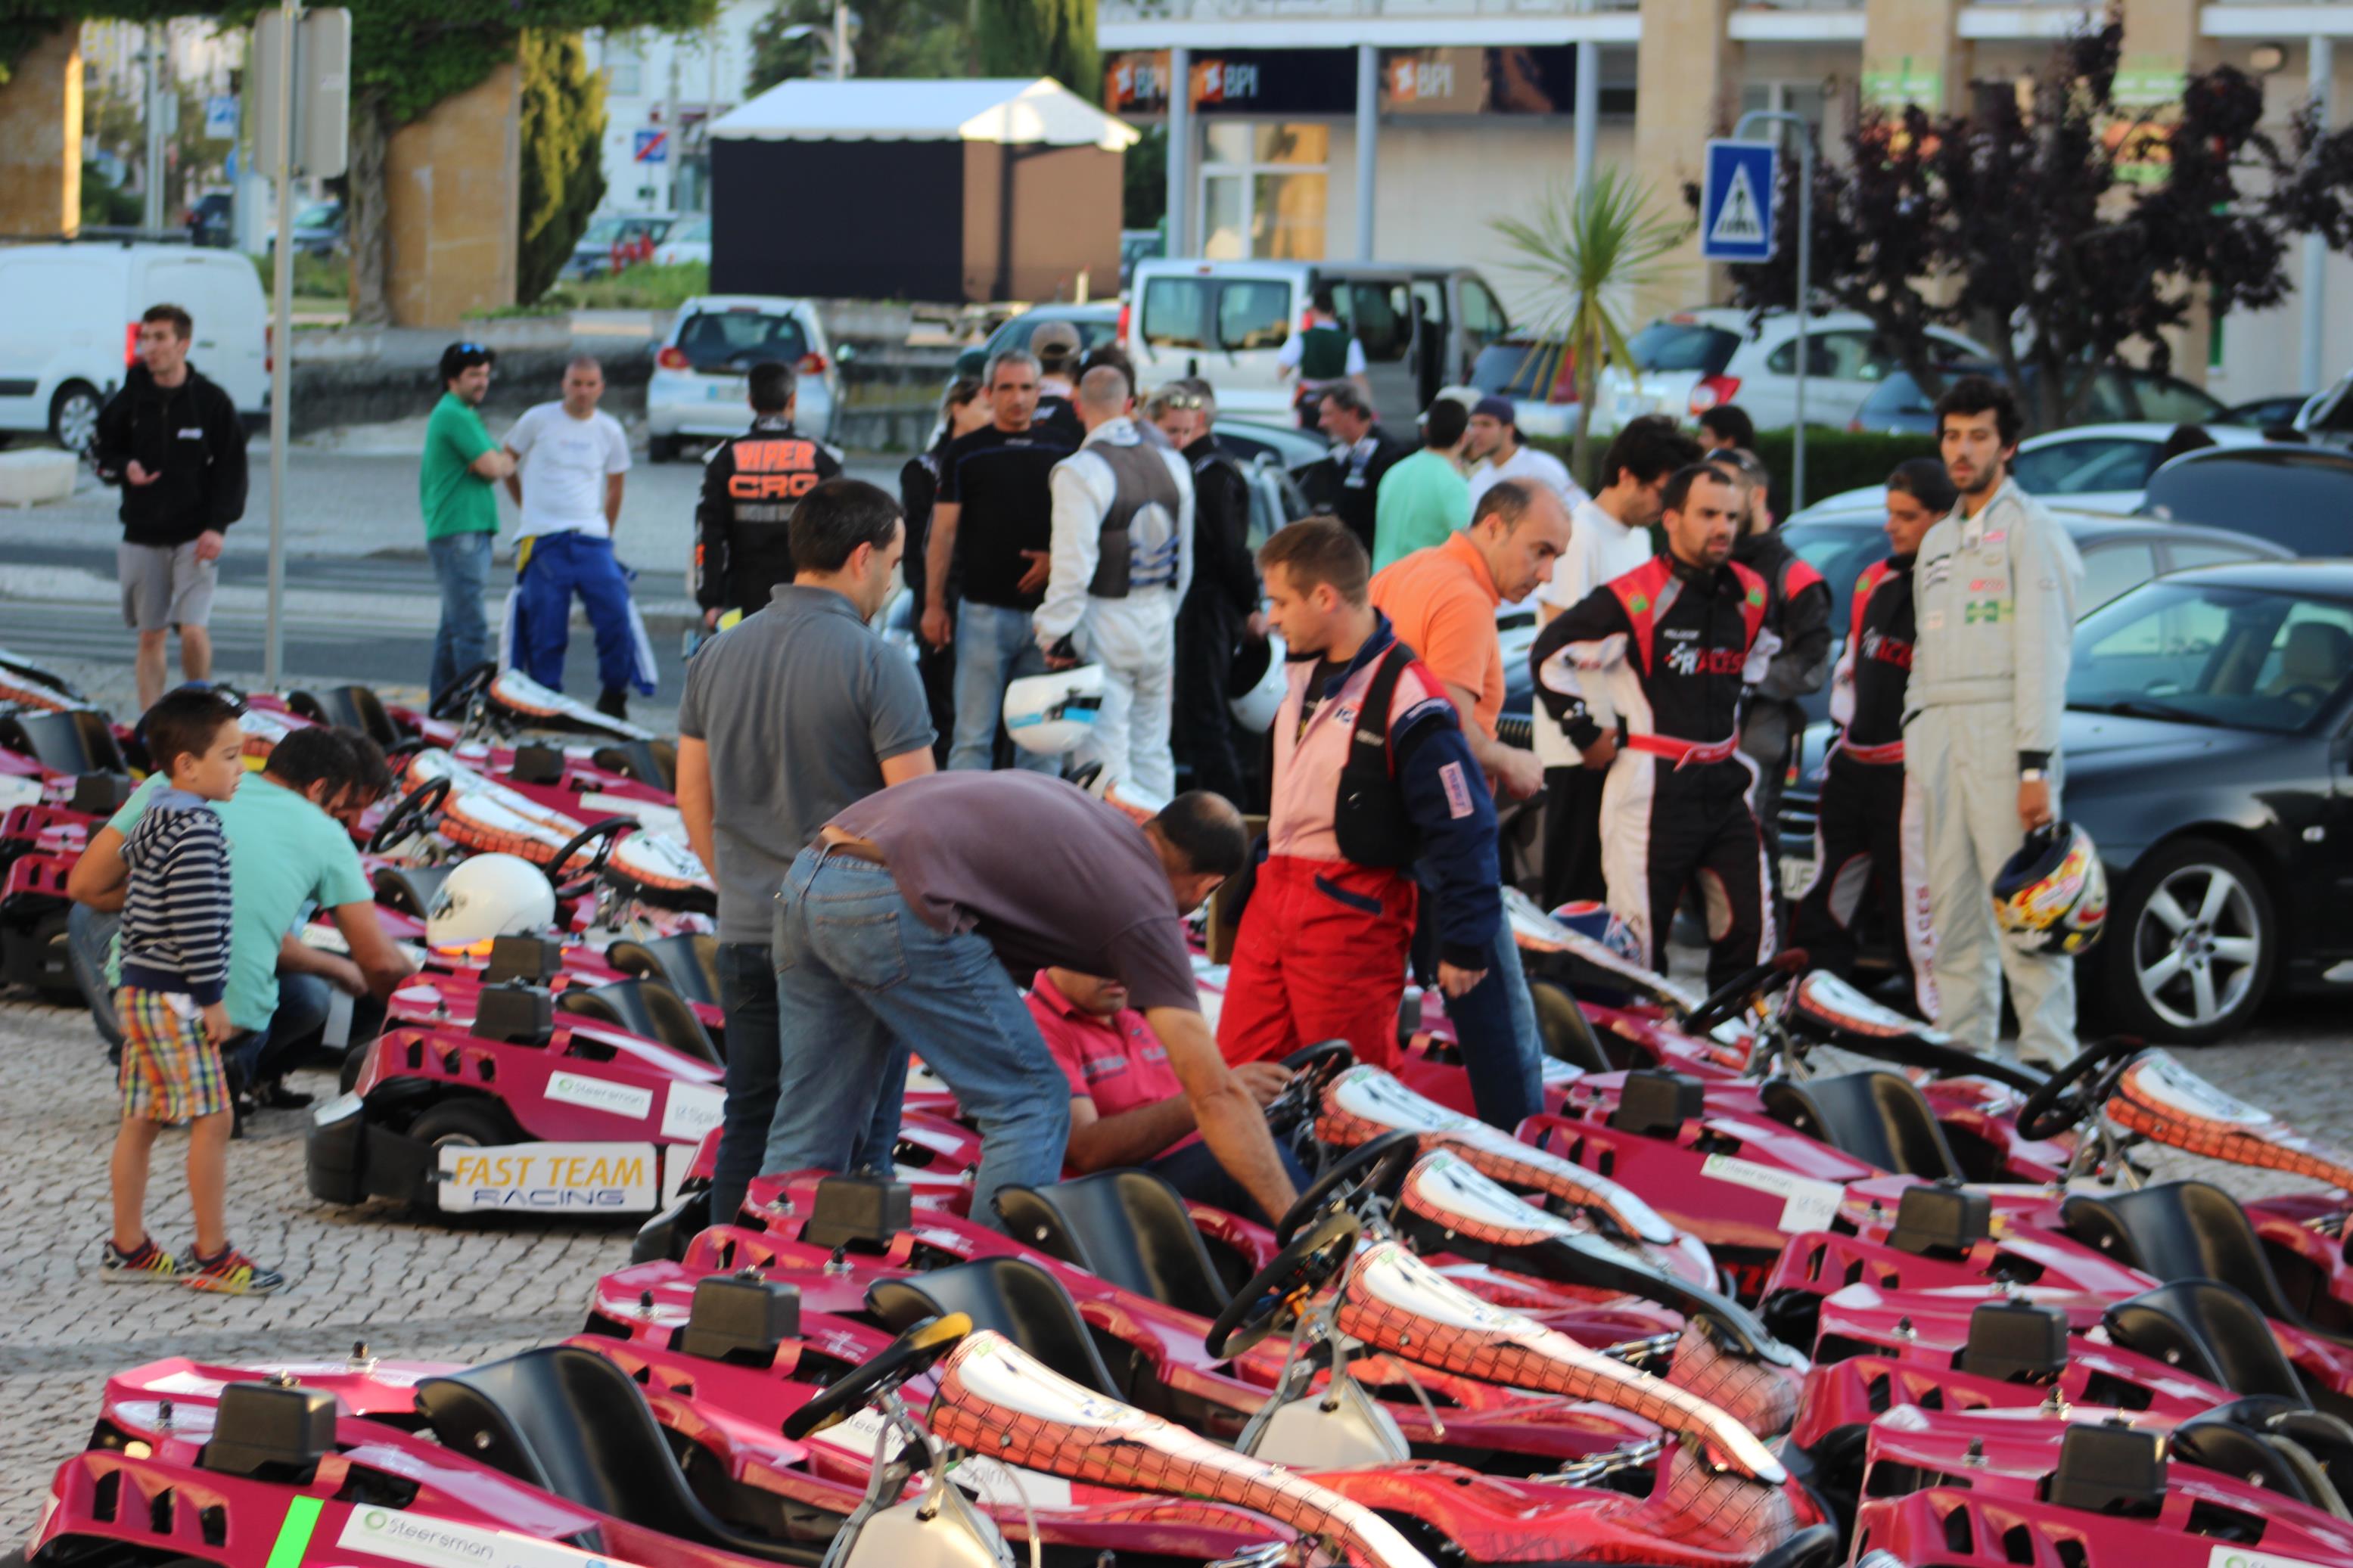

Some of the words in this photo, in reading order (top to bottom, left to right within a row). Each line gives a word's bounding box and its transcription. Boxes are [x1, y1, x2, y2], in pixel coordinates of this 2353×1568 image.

[1135, 67, 1167, 98] BPI
[1223, 64, 1258, 98] BPI
[1417, 63, 1453, 98] BPI
[732, 439, 816, 473] VIPER
[727, 473, 819, 499] CRG
[453, 1156, 535, 1188] FAST
[547, 1157, 643, 1188] TEAM
[473, 1188, 625, 1206] RACING
[387, 1517, 495, 1560] Steersman
